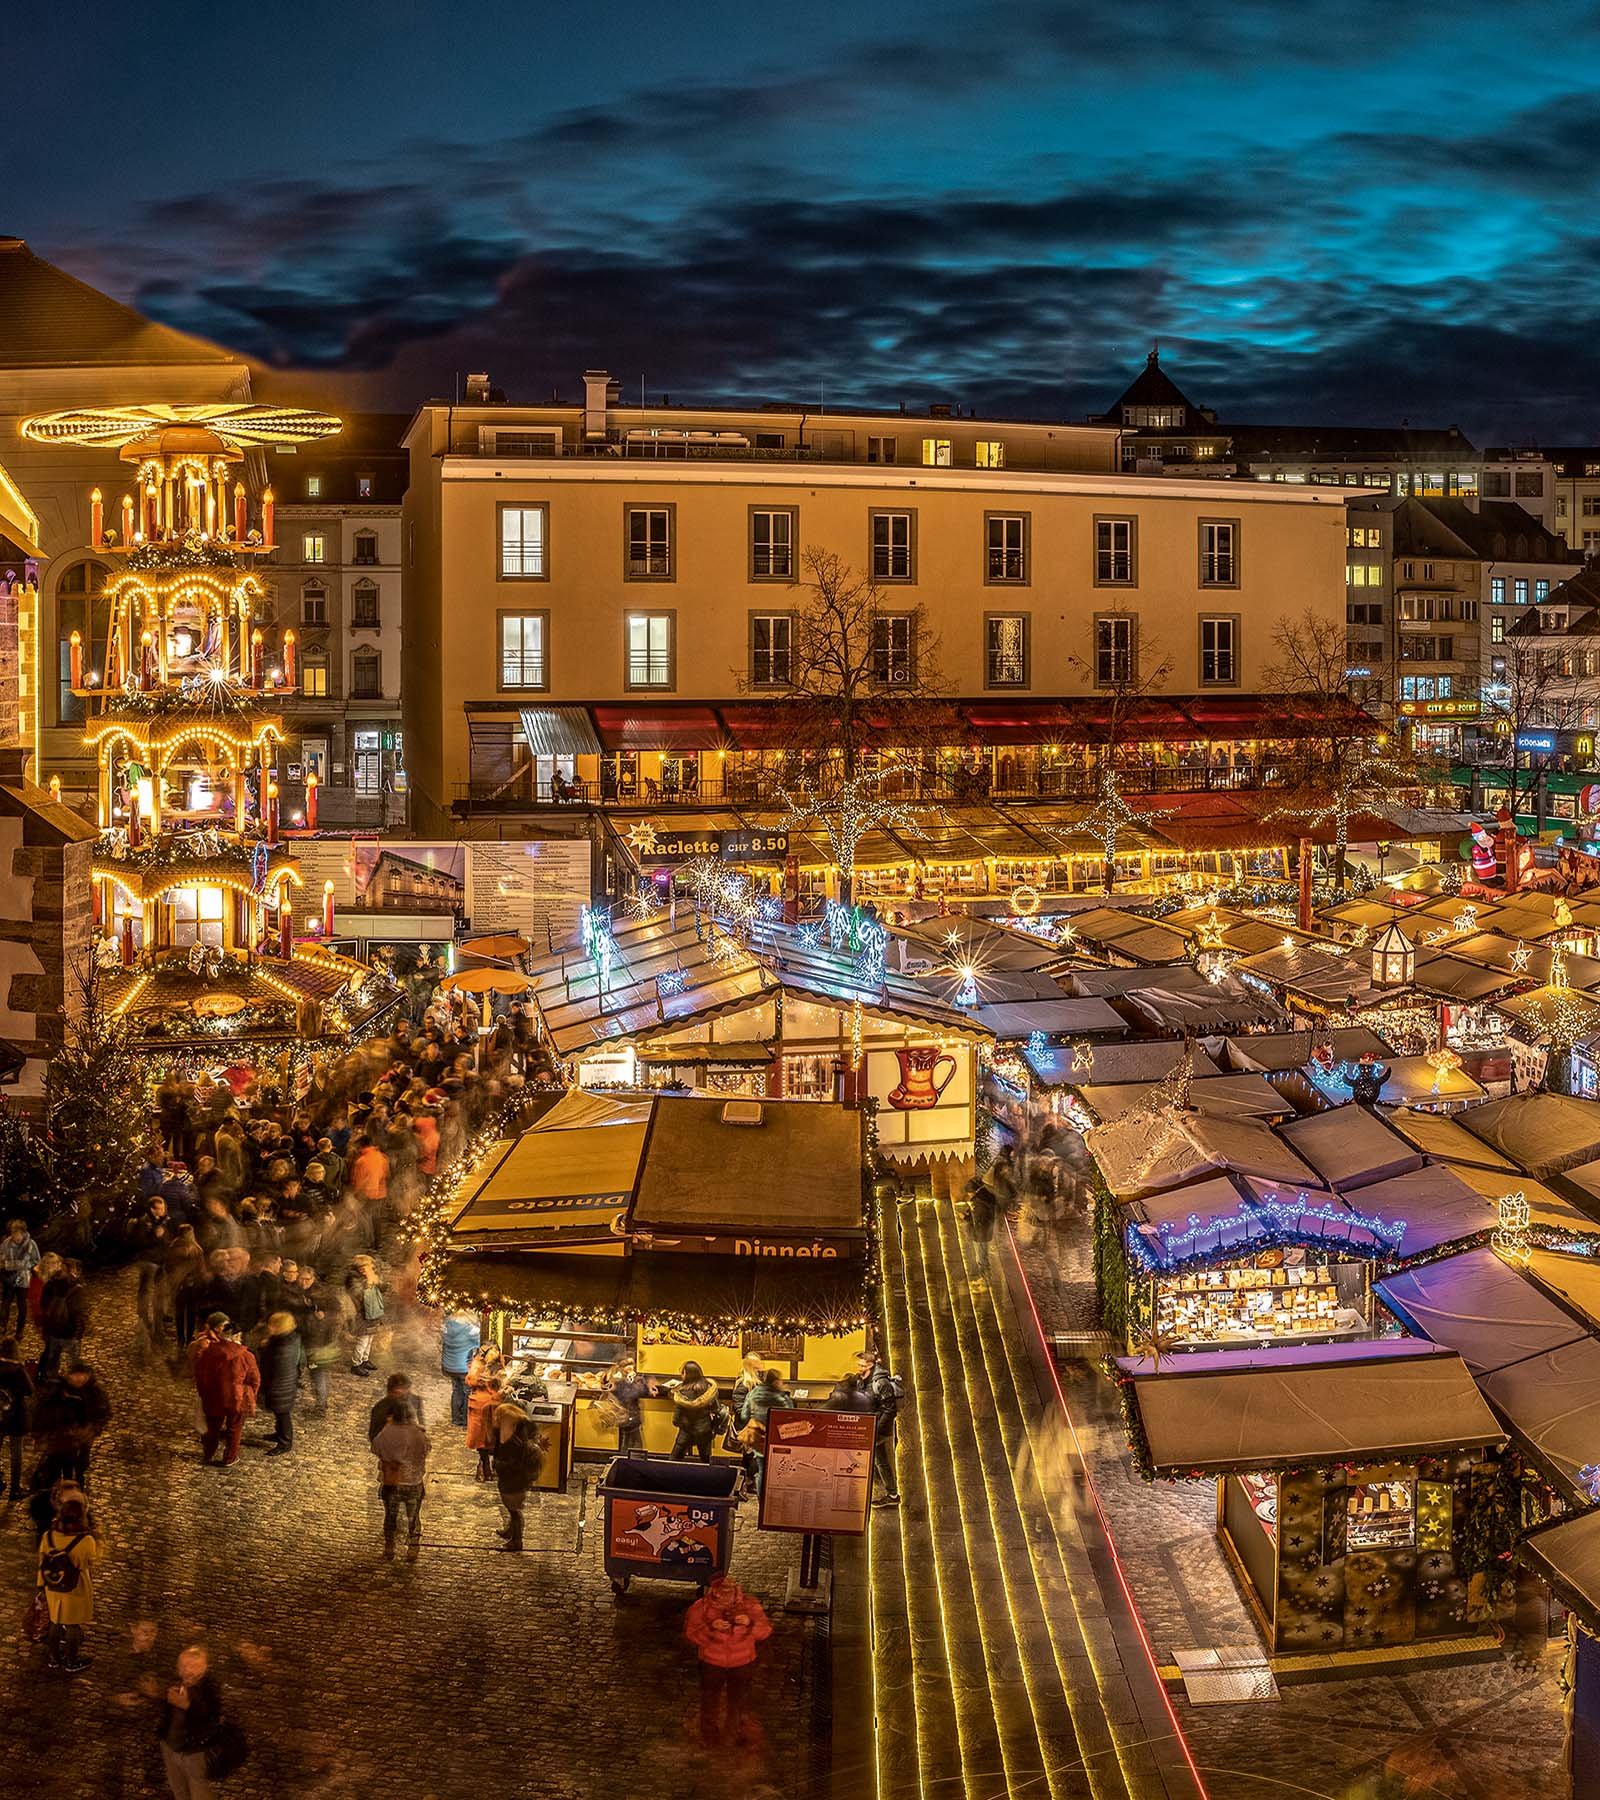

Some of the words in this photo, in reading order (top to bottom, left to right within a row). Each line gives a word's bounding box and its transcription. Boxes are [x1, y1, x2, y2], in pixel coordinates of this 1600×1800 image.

[643, 840, 720, 856] Raclette
[727, 844, 749, 852] CHF
[751, 838, 787, 851] 8.50
[735, 1239, 837, 1258] Dinnete
[692, 1509, 714, 1521] Da!
[615, 1536, 639, 1546] easy!
